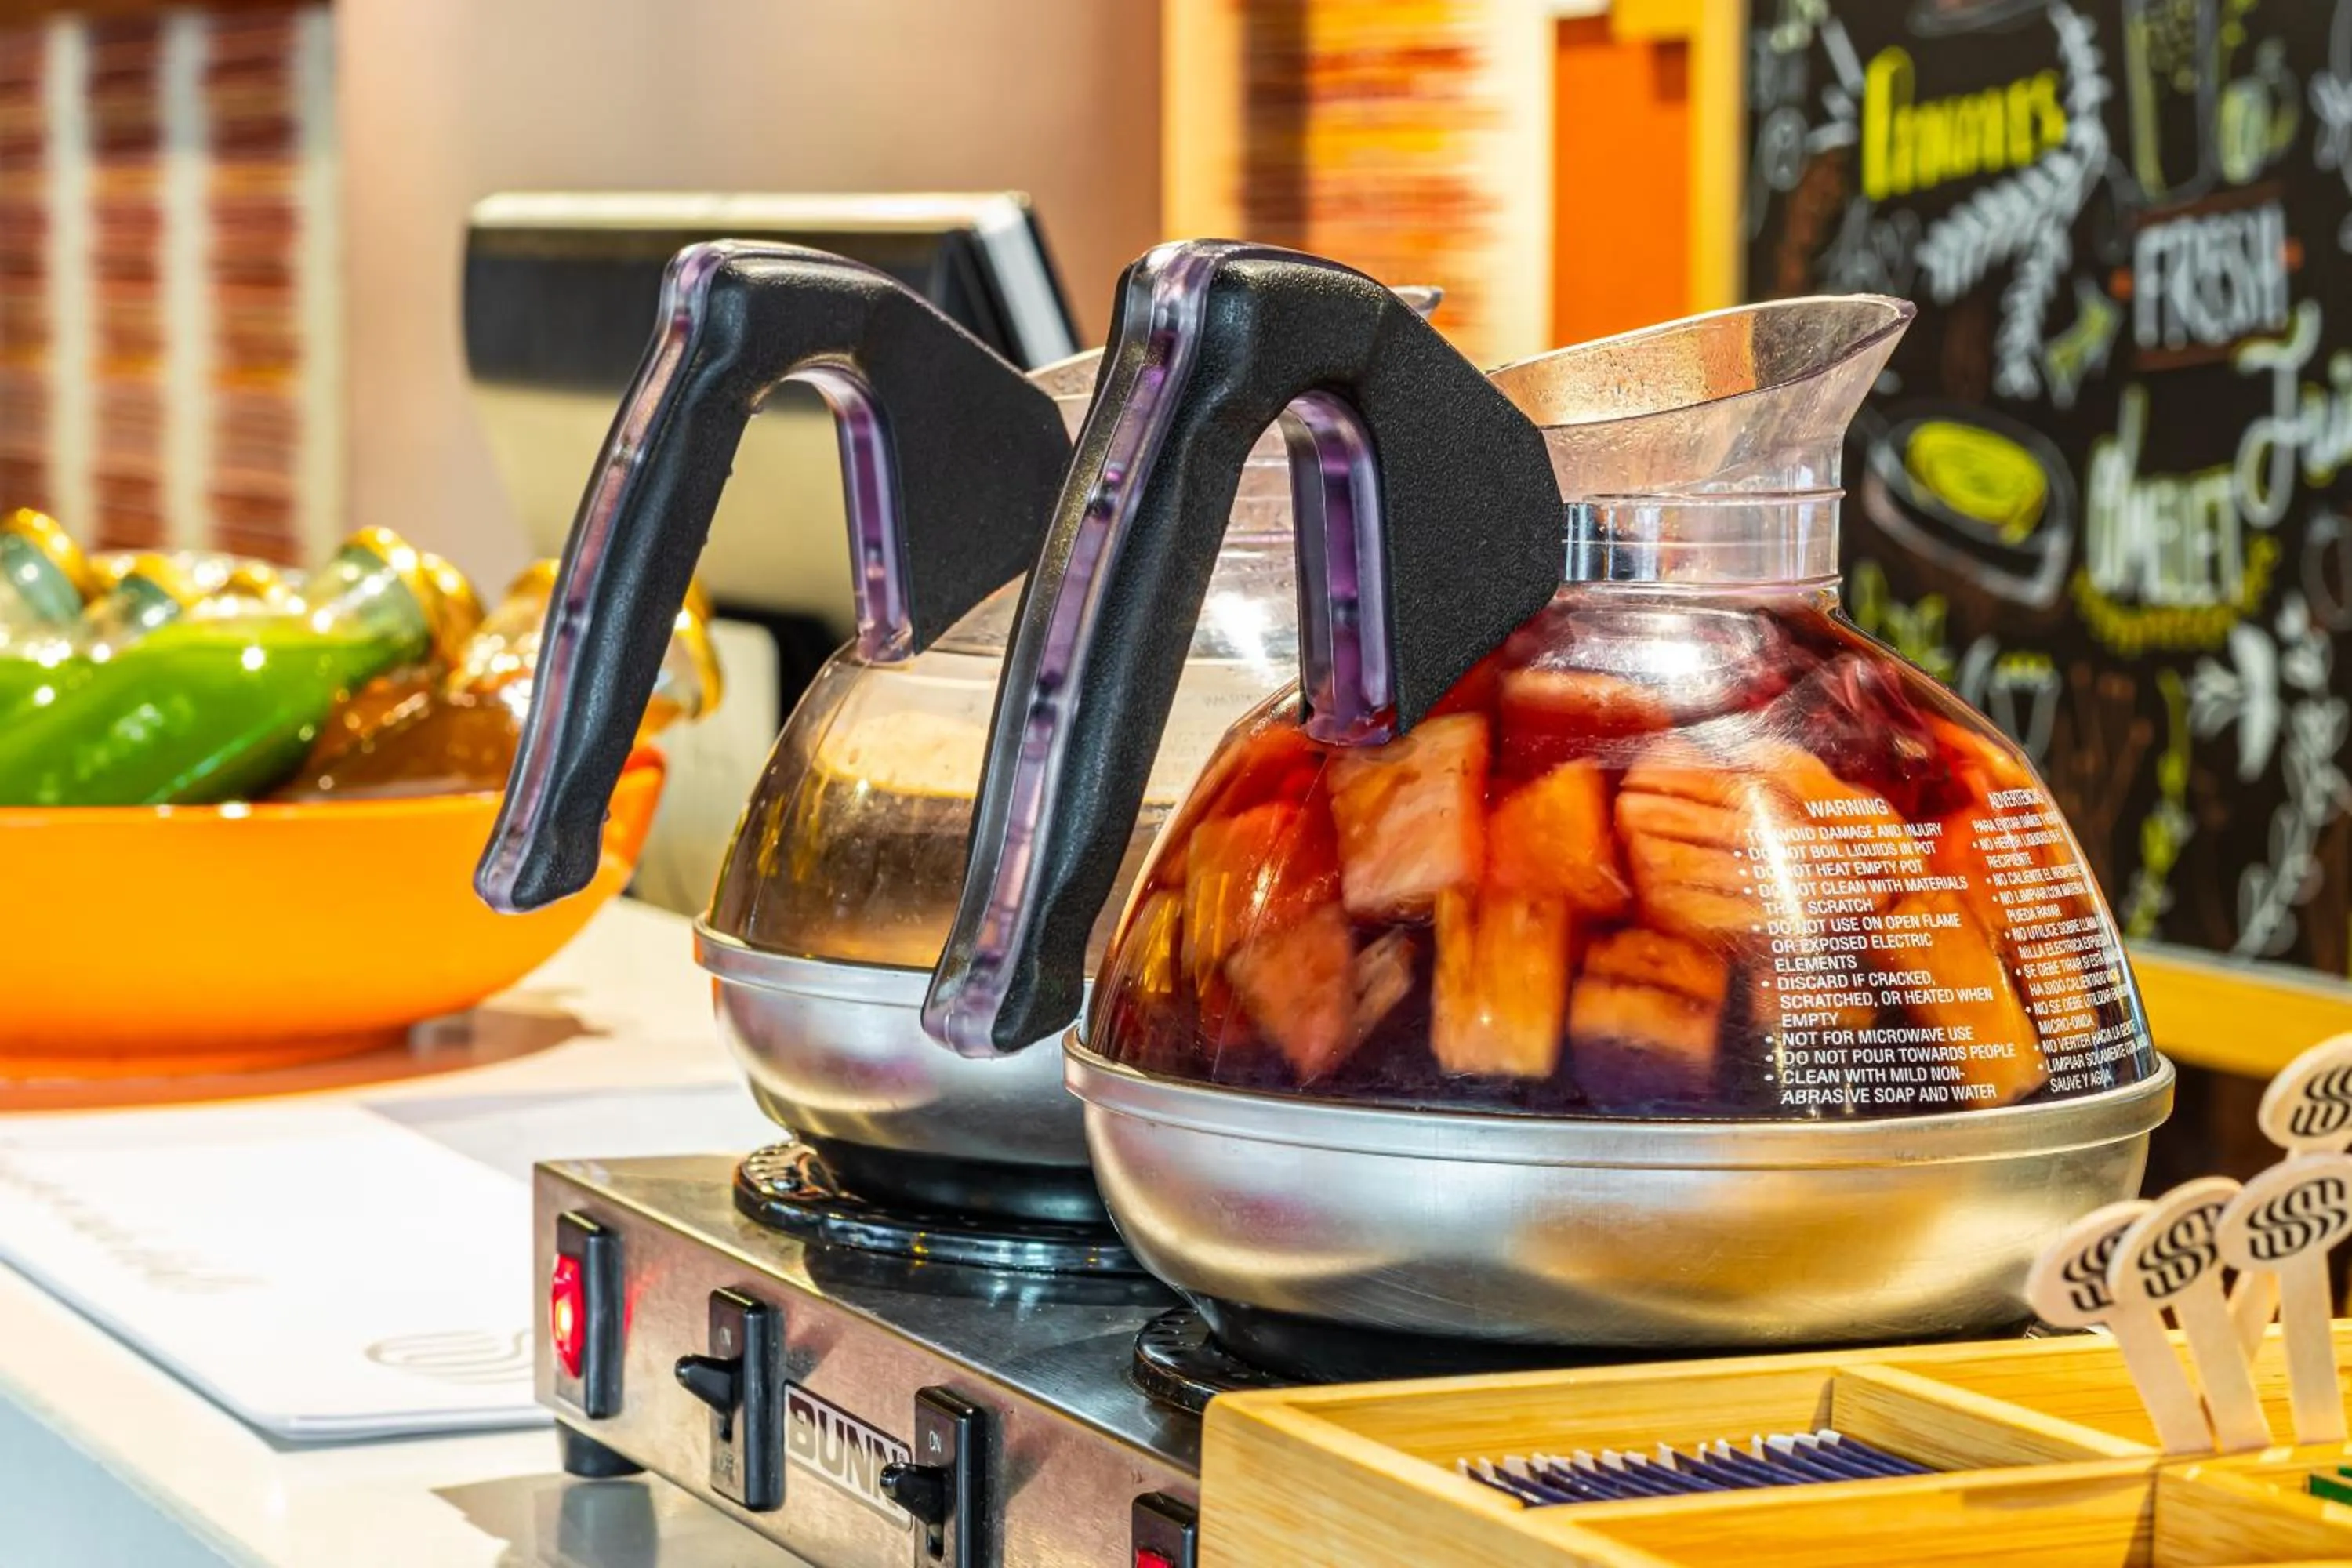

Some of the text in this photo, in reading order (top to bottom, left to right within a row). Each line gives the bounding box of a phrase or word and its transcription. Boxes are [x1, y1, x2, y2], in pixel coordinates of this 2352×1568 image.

[1805, 798, 1889, 818] WARNING
[1818, 825, 1875, 840] DAMAGE
[1878, 823, 1902, 838] AND
[1904, 823, 1942, 837] INJURY
[1777, 845, 1806, 859] OT
[1809, 844, 1844, 858] BOIL
[1846, 842, 1898, 857] LIQUIDS
[1900, 841, 1913, 855] IN
[1913, 840, 1936, 855] POT
[1978, 837, 1994, 851] NO
[1816, 862, 1851, 877] HEAT
[1853, 861, 1896, 875] EMPTY
[1900, 859, 1923, 873] POT
[1820, 880, 1867, 895] CLEAN
[1868, 878, 1904, 893] WITH
[1904, 876, 1969, 891] MATERIALS
[1992, 873, 2008, 887] NO
[1807, 898, 1874, 915] SCRATCH
[1999, 890, 2014, 905] NO
[1766, 913, 1962, 935] DO NOT USE ON OPEN FLAME
[1771, 933, 1933, 953] OR EXPOSED ELECTRIC
[2011, 927, 2027, 942] NO
[1775, 955, 1857, 972] ELEMENTS
[2023, 964, 2036, 979] SE
[1777, 970, 1936, 990] DISCARD IF CRACKED,
[2028, 981, 2045, 996] HA
[1780, 987, 1994, 1009] SCRATCHED, OR HEATED WHEN
[2033, 1000, 2049, 1016] NO
[2049, 998, 2063, 1014] SE
[1781, 1012, 1839, 1028] EMPTY
[1782, 1026, 1974, 1046] NOT FOR MICROWAVE USE
[2042, 1039, 2058, 1054] NO
[2056, 1033, 2092, 1051] VERTER
[1783, 1044, 2017, 1065] DO NOT POUR TOWARDS PEOPLE
[2045, 1053, 2086, 1073] LIMPIAR
[1782, 1066, 1965, 1084] CLEAN WITH MILD NON-
[2049, 1076, 2082, 1094] SAUVE
[1780, 1084, 1998, 1105] ABRASIVE SOAP AND WATER
[929, 1430, 942, 1453] ON
